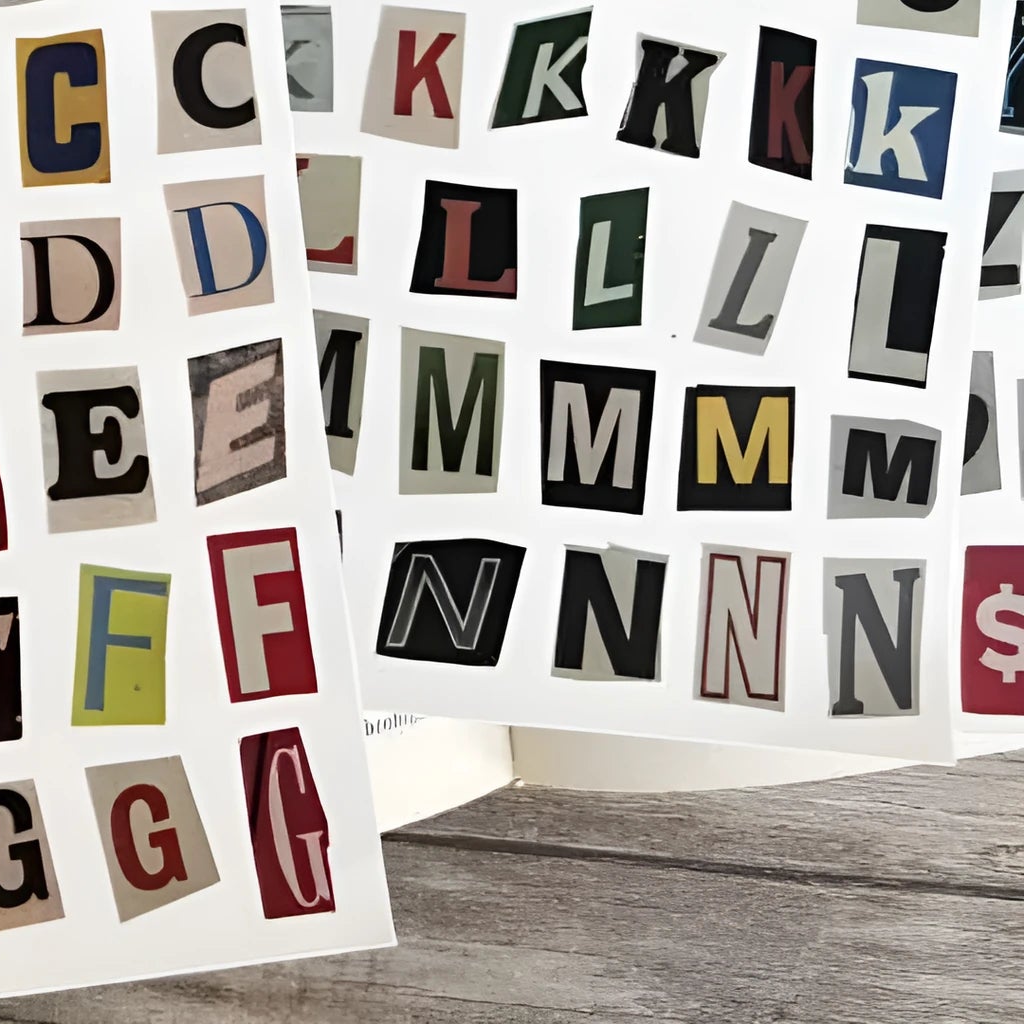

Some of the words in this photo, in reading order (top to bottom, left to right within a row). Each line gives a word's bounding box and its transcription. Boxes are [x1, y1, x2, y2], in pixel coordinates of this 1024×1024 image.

[24, 42, 102, 173] C
[173, 23, 256, 128] C
[393, 31, 457, 119] K
[523, 36, 588, 118] K
[620, 40, 719, 157] K
[767, 62, 814, 163] K
[23, 234, 113, 326] D
[173, 202, 267, 297] D
[435, 200, 516, 291] L
[584, 220, 633, 306] L
[710, 228, 778, 339] L
[851, 238, 927, 372] L
[42, 387, 150, 500] E
[197, 353, 276, 492] E
[412, 346, 498, 476] M
[547, 382, 639, 489] M
[695, 396, 788, 484] M
[842, 429, 936, 505] M
[84, 578, 167, 710] F
[223, 543, 299, 694] F
[385, 553, 500, 650] N
[555, 553, 665, 678] N
[700, 553, 786, 701] N
[832, 568, 920, 716] N
[109, 784, 187, 890] G
[265, 744, 330, 909] G
